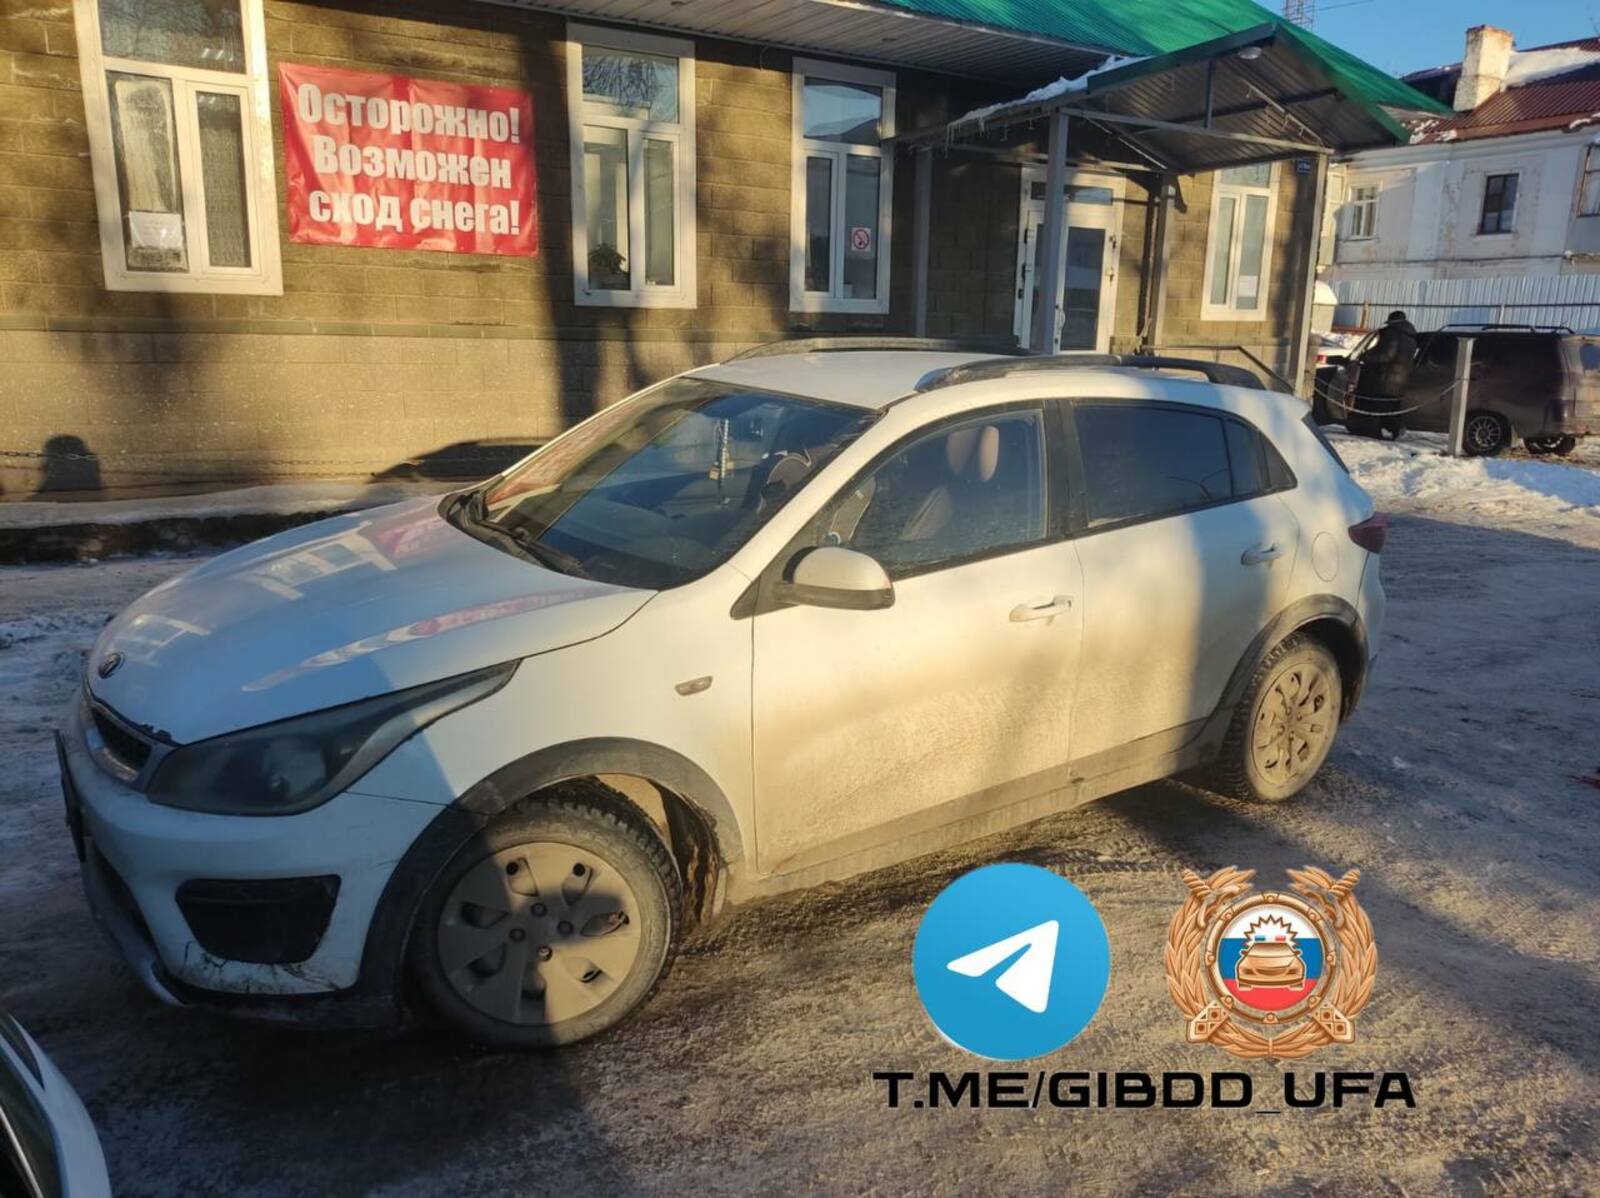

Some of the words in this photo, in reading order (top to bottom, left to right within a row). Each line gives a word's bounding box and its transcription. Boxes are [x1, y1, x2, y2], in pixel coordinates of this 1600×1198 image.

[297, 83, 520, 144] Осторожно!
[313, 134, 511, 189] Возможен
[309, 190, 403, 232] сход
[410, 197, 520, 235] снега!
